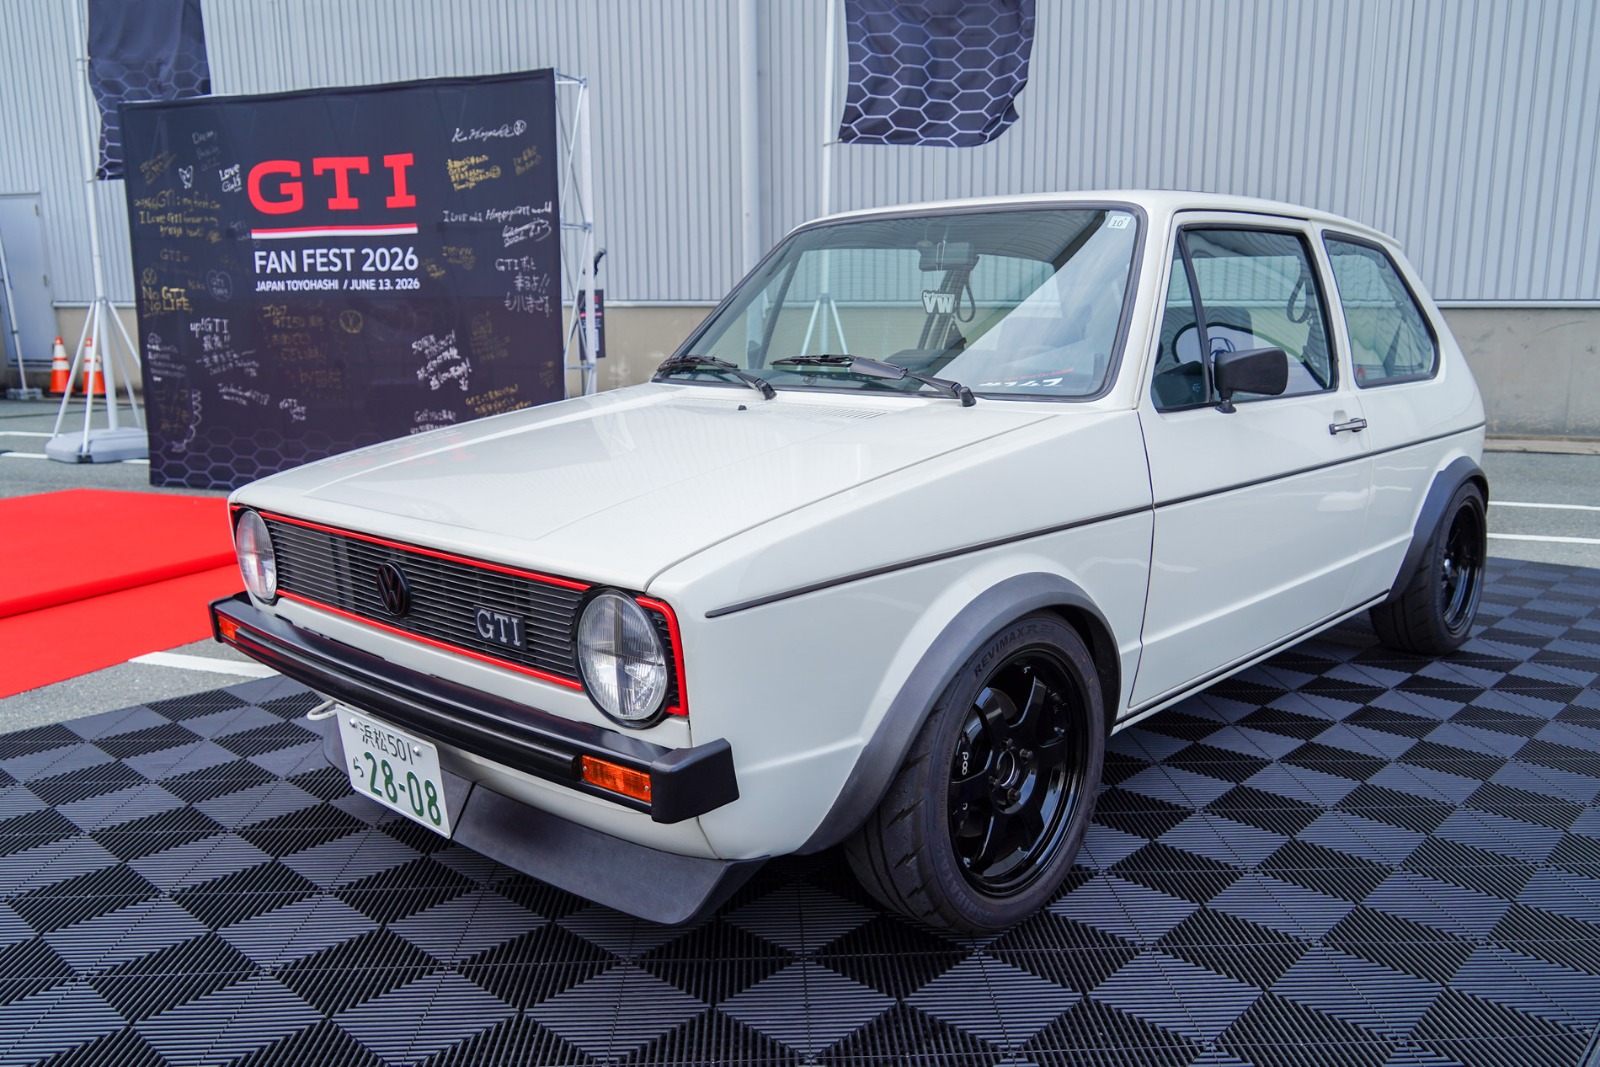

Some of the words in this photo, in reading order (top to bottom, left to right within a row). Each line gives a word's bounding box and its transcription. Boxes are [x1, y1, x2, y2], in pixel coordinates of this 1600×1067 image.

[218, 163, 241, 181] Love
[221, 174, 242, 192] Golf
[247, 152, 417, 215] GTI
[254, 250, 297, 274] FAN
[302, 248, 355, 273] FEST
[361, 247, 419, 271] 2026
[255, 281, 285, 291] JAPAN
[286, 279, 339, 291] TOYOHASHI
[349, 280, 376, 290] JUNE
[395, 278, 420, 290] 2026
[476, 608, 521, 647] GTI
[974, 627, 1025, 678] REVIMAX
[387, 733, 414, 766] 501
[363, 751, 442, 826] 28-08
